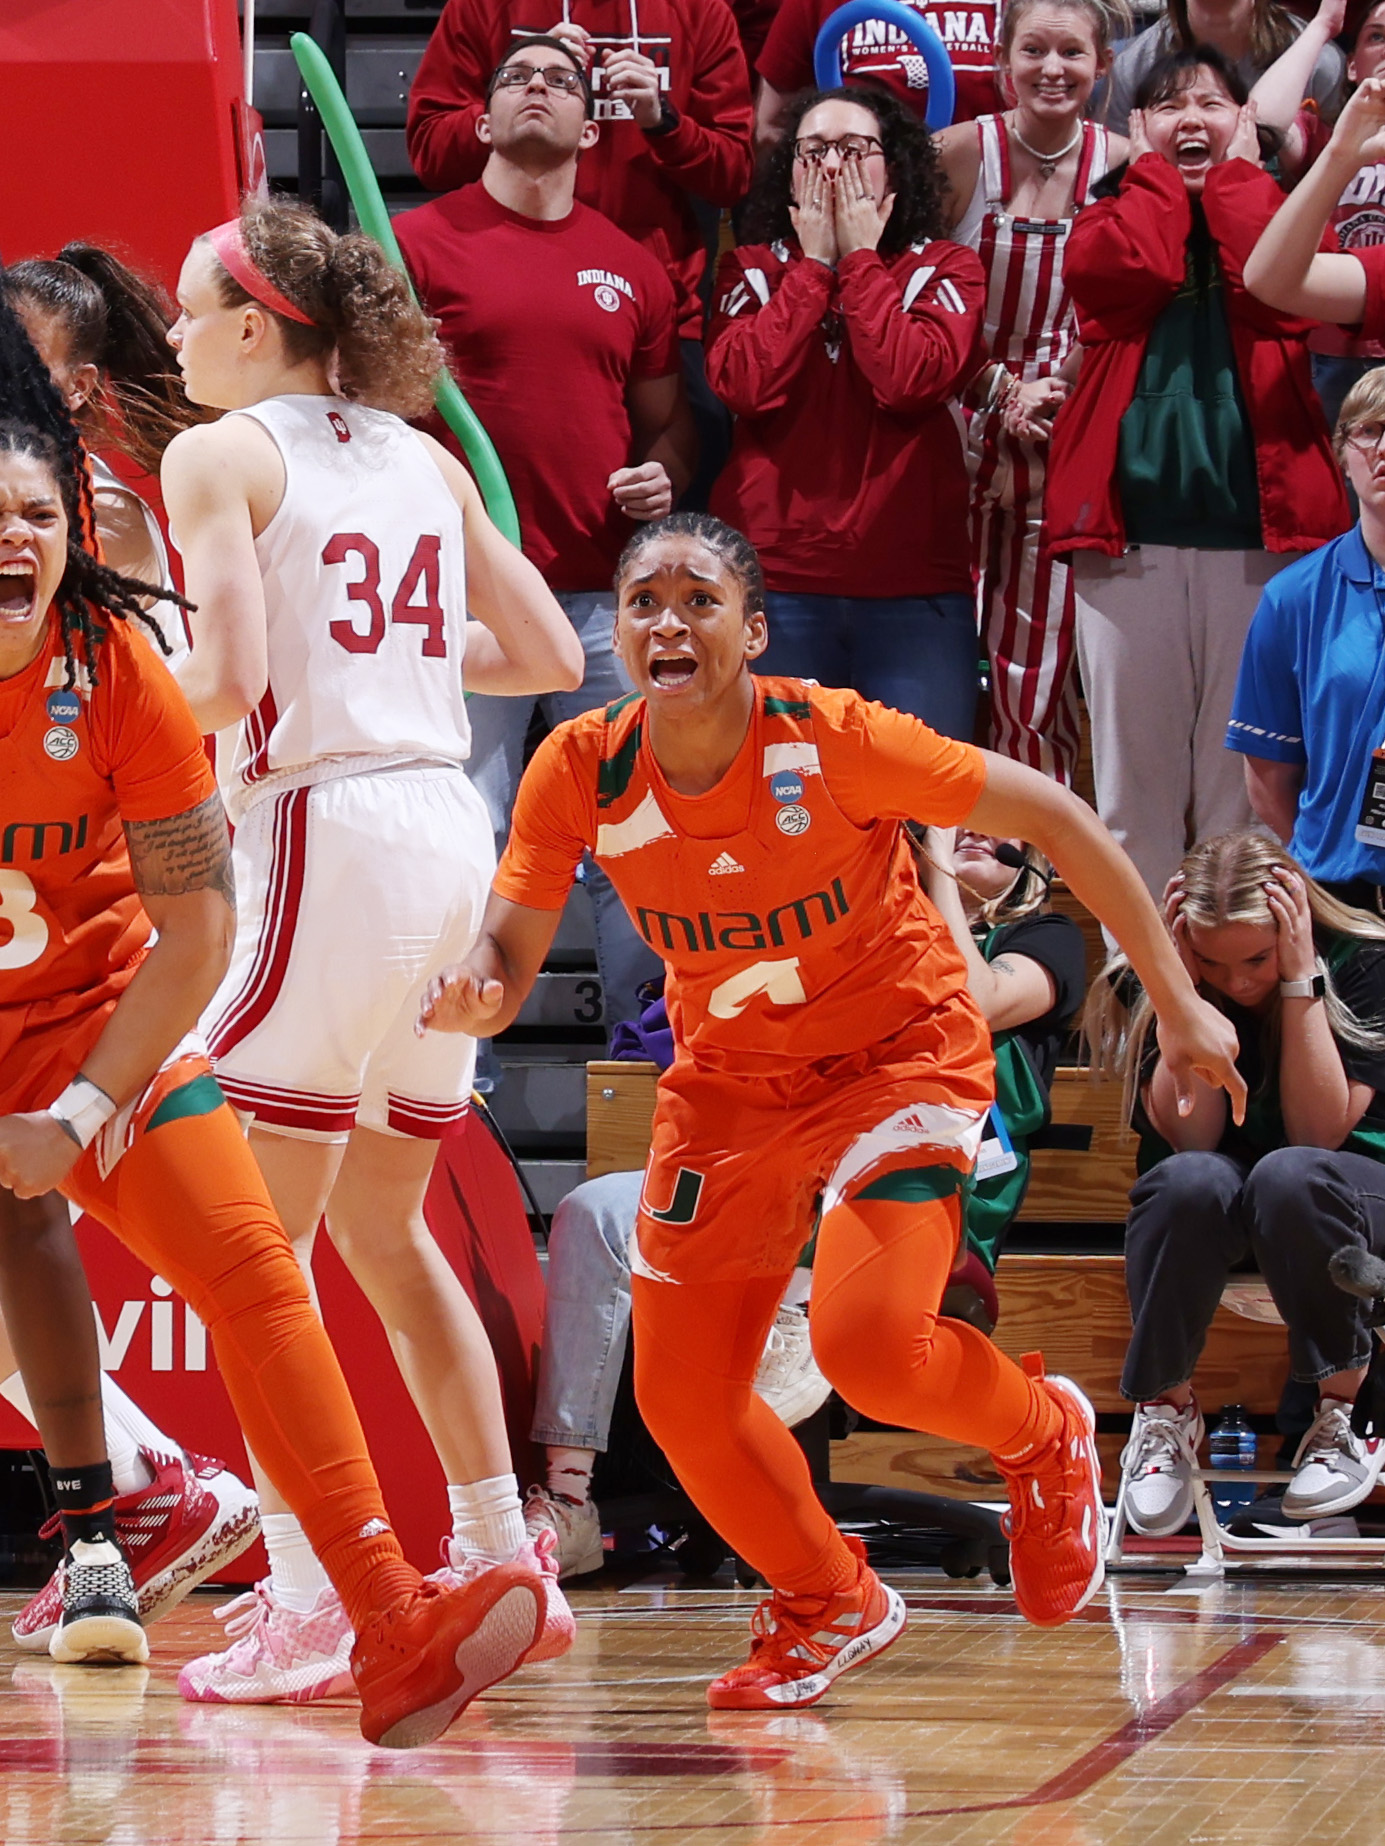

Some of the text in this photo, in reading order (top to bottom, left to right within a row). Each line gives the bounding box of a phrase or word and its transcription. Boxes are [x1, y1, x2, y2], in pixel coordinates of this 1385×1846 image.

[852, 11, 992, 47] INDANA
[577, 268, 634, 299] INDIANA
[322, 532, 447, 659] 34
[50, 705, 80, 716] NCAA
[775, 785, 802, 797] NCAA
[708, 864, 745, 876] adidas
[574, 980, 604, 1024] 3
[892, 1125, 930, 1135] adidas
[56, 1479, 82, 1491] BYE
